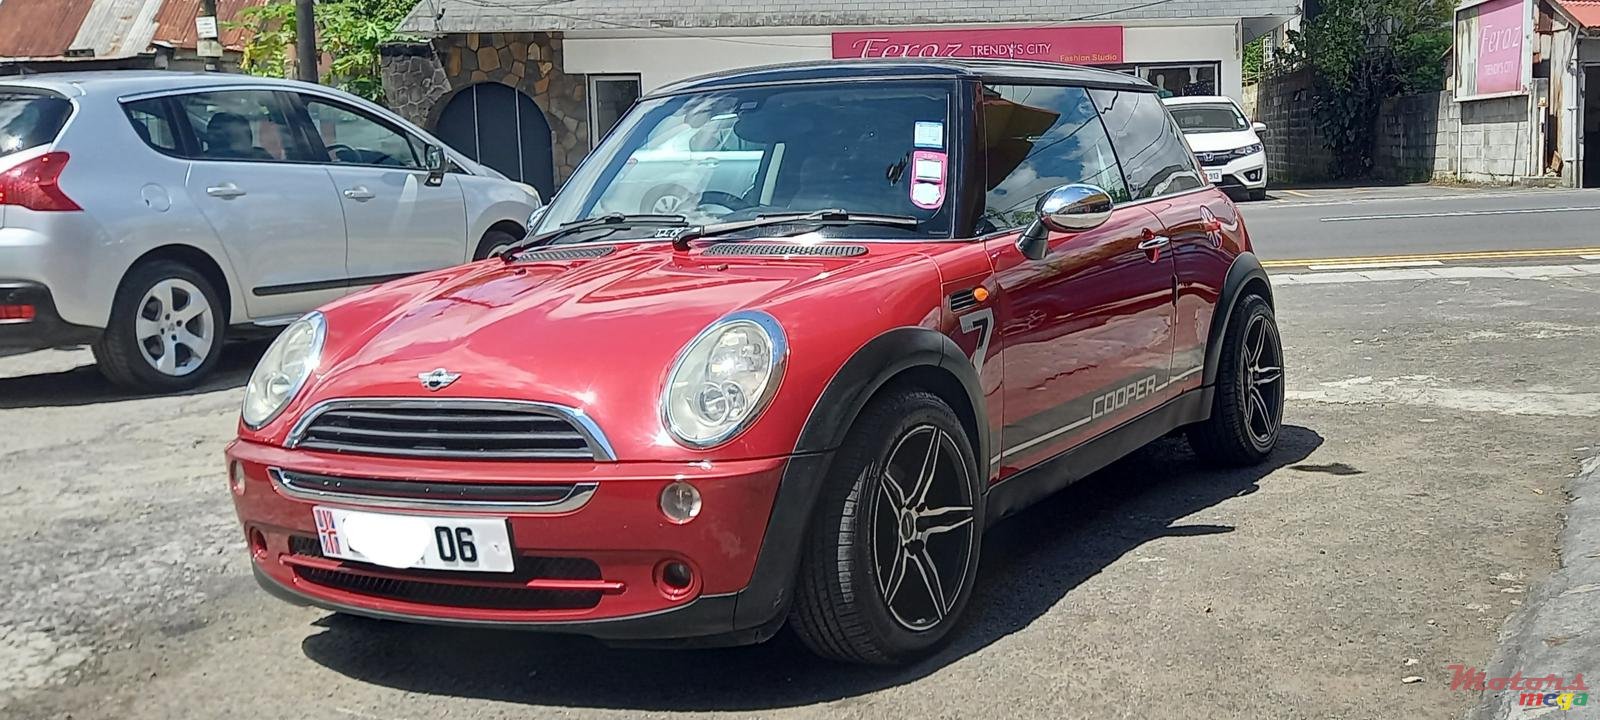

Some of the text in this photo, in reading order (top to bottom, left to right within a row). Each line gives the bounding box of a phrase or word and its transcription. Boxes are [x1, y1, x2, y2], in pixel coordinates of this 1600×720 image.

[852, 38, 962, 58] Feroz
[1026, 43, 1051, 54] CITY
[1060, 54, 1118, 62] Fashion Studio
[1480, 25, 1521, 58] Feroz
[1092, 374, 1156, 419] COOPER
[434, 526, 477, 562] 06
